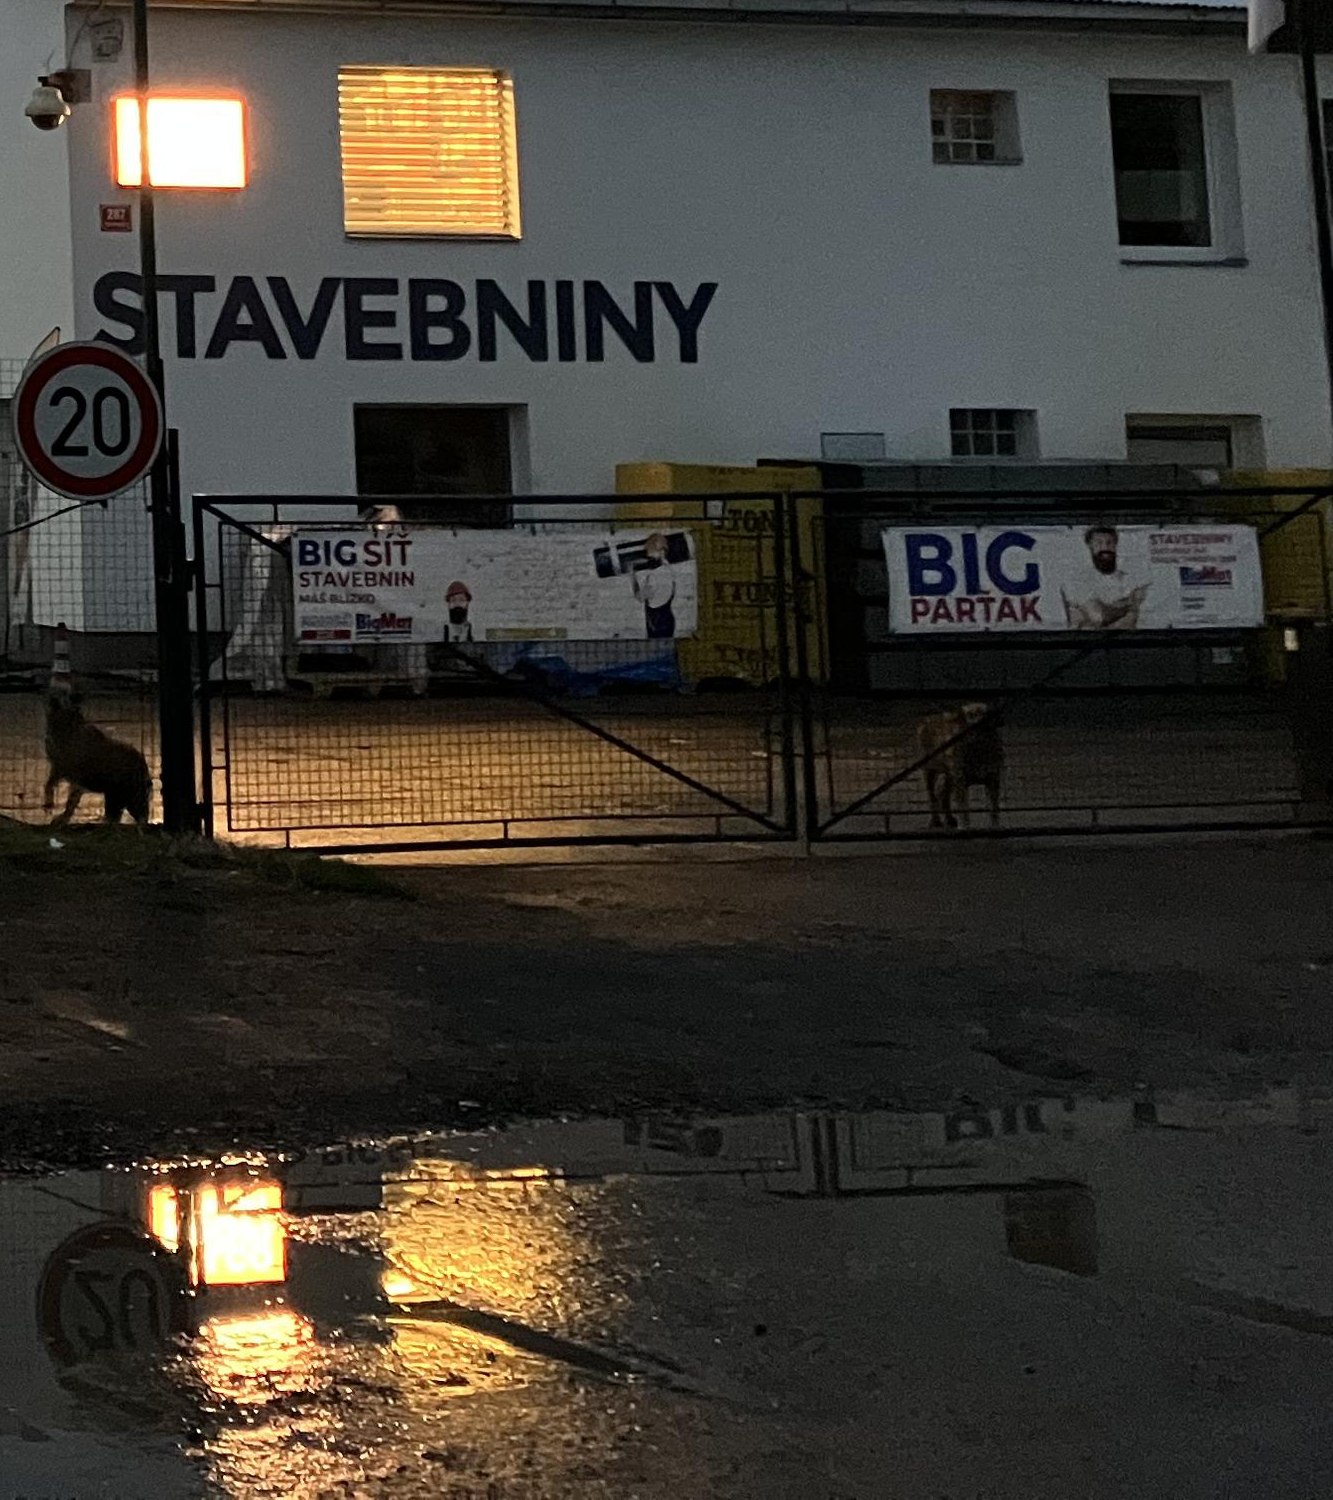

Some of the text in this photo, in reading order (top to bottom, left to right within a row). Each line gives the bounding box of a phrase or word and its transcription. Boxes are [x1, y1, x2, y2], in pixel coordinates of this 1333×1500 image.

[92, 270, 719, 364] STAVEBNINY
[48, 386, 131, 458] 20
[299, 533, 413, 567] BIG SÍŤ
[299, 571, 415, 588] STAVEBNIN
[905, 531, 1041, 596] BIG
